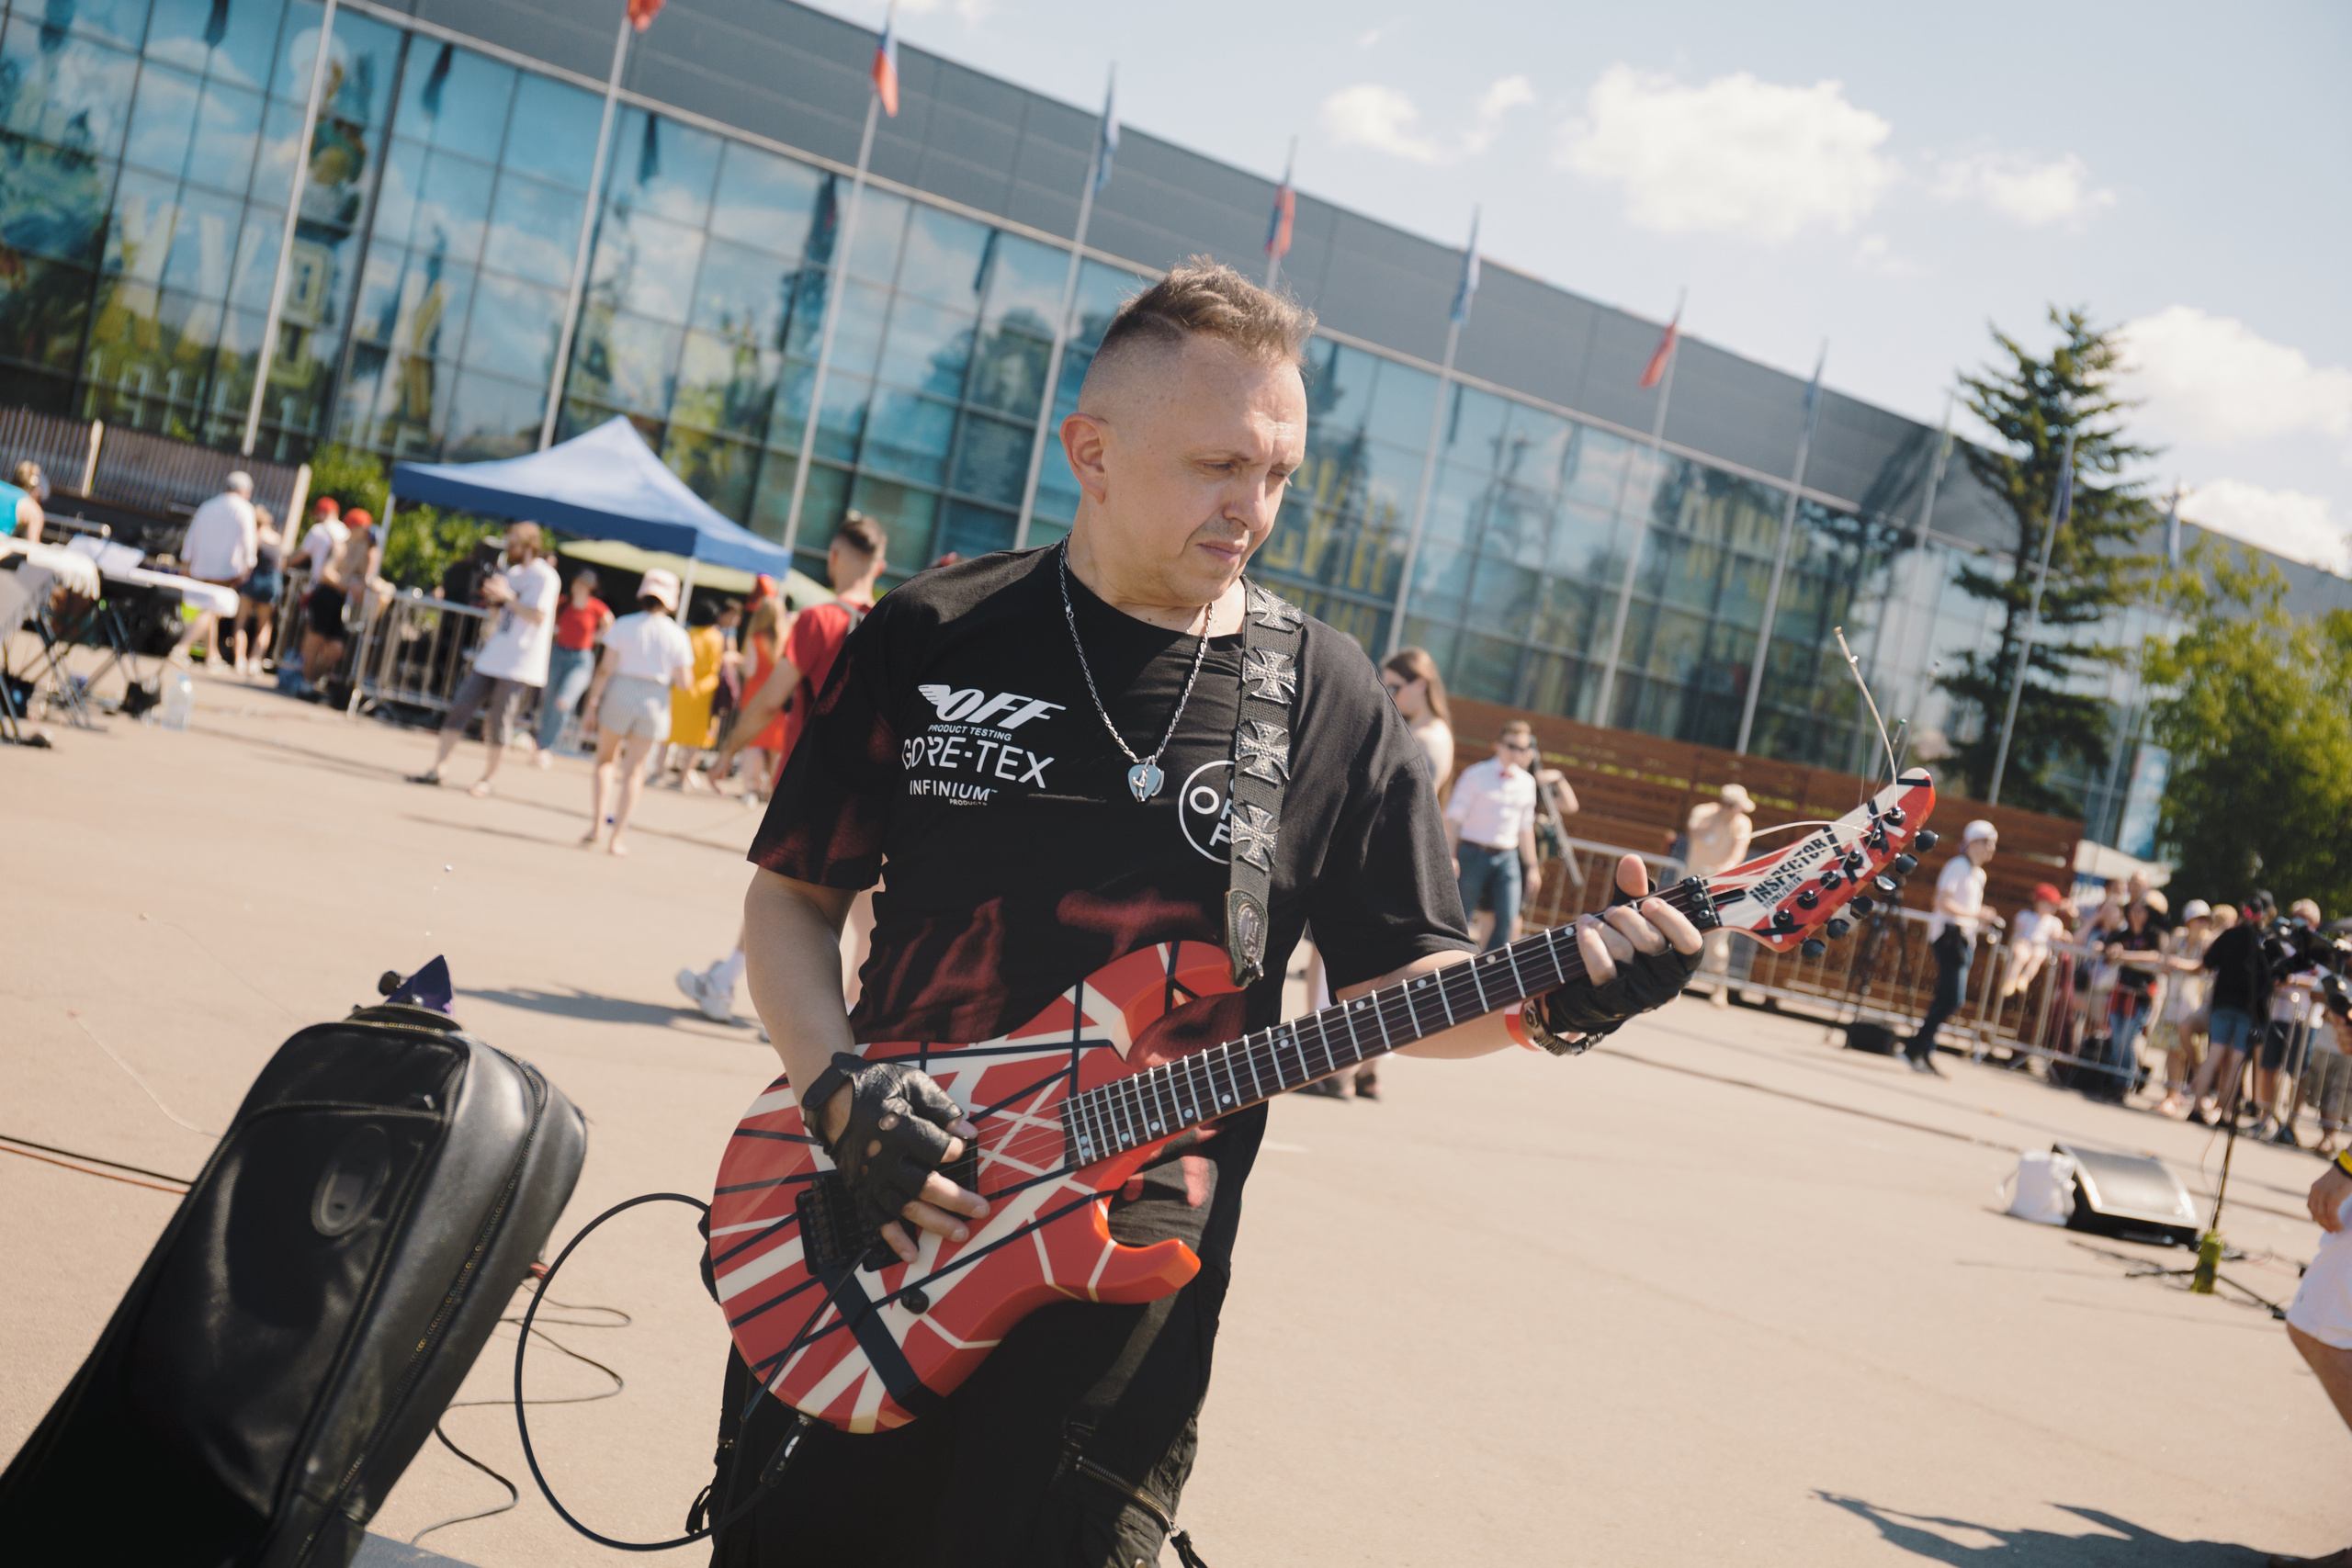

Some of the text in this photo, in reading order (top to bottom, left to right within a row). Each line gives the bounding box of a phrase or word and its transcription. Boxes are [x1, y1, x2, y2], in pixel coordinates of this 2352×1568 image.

[934, 688, 1067, 729] OFF
[928, 724, 1012, 741] PRODUCT TESTING
[901, 736, 1055, 789] GORE-TEX
[1748, 838, 1827, 904] INSPECTOR
